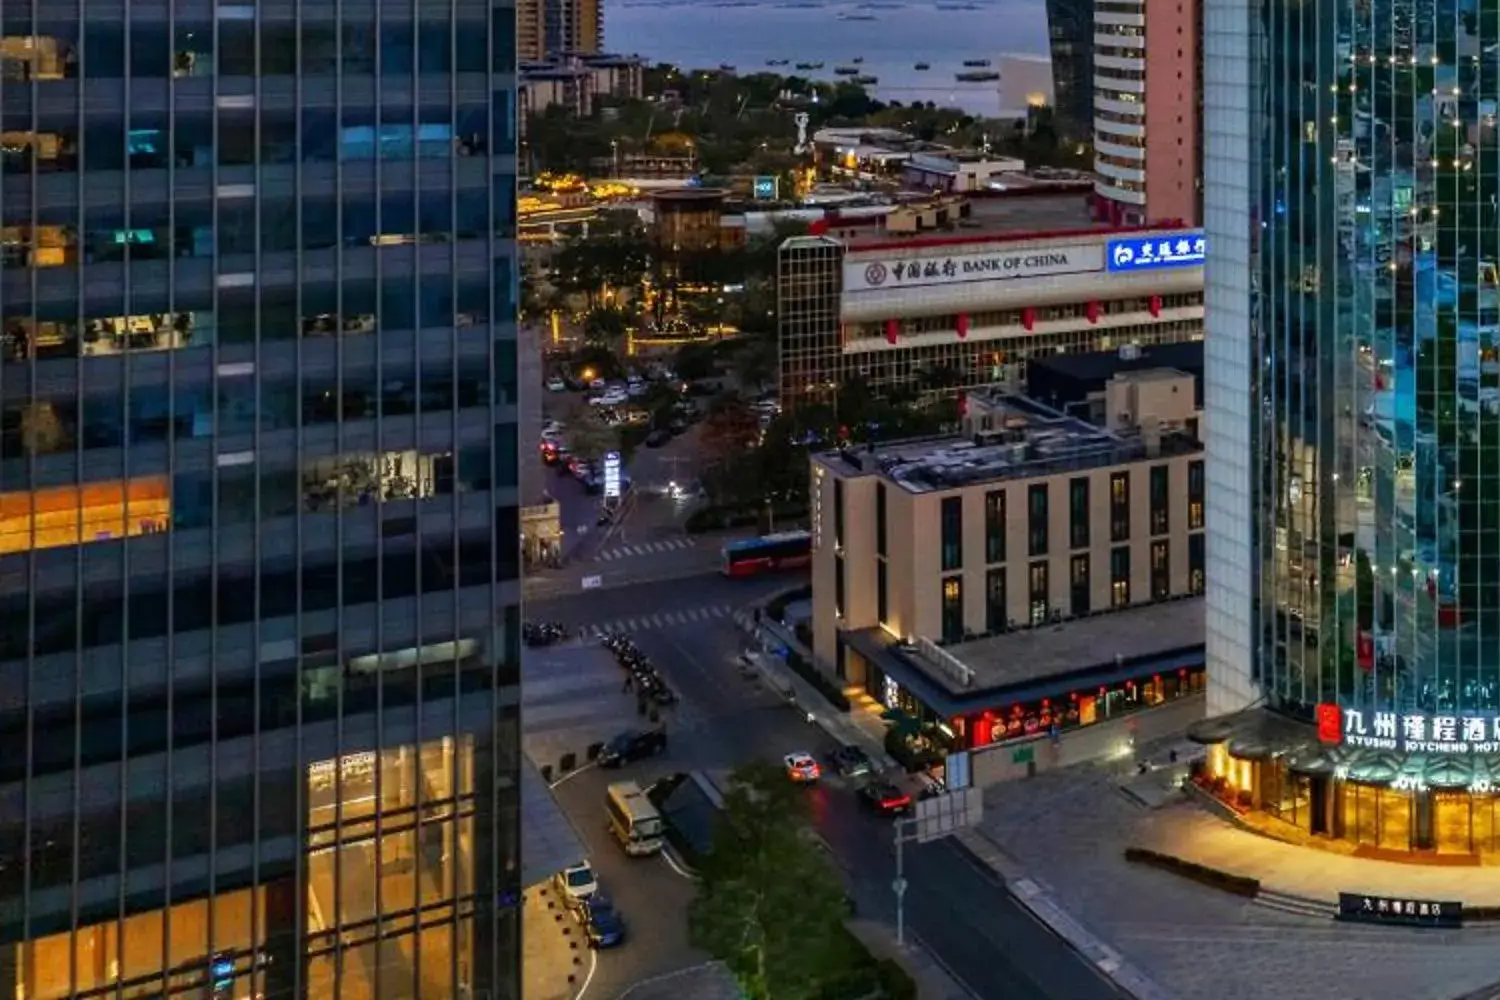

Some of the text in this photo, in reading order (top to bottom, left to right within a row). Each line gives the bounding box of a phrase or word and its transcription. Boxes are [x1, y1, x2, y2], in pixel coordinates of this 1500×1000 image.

[892, 253, 1068, 280] 中国银行 BANK OF CHINA
